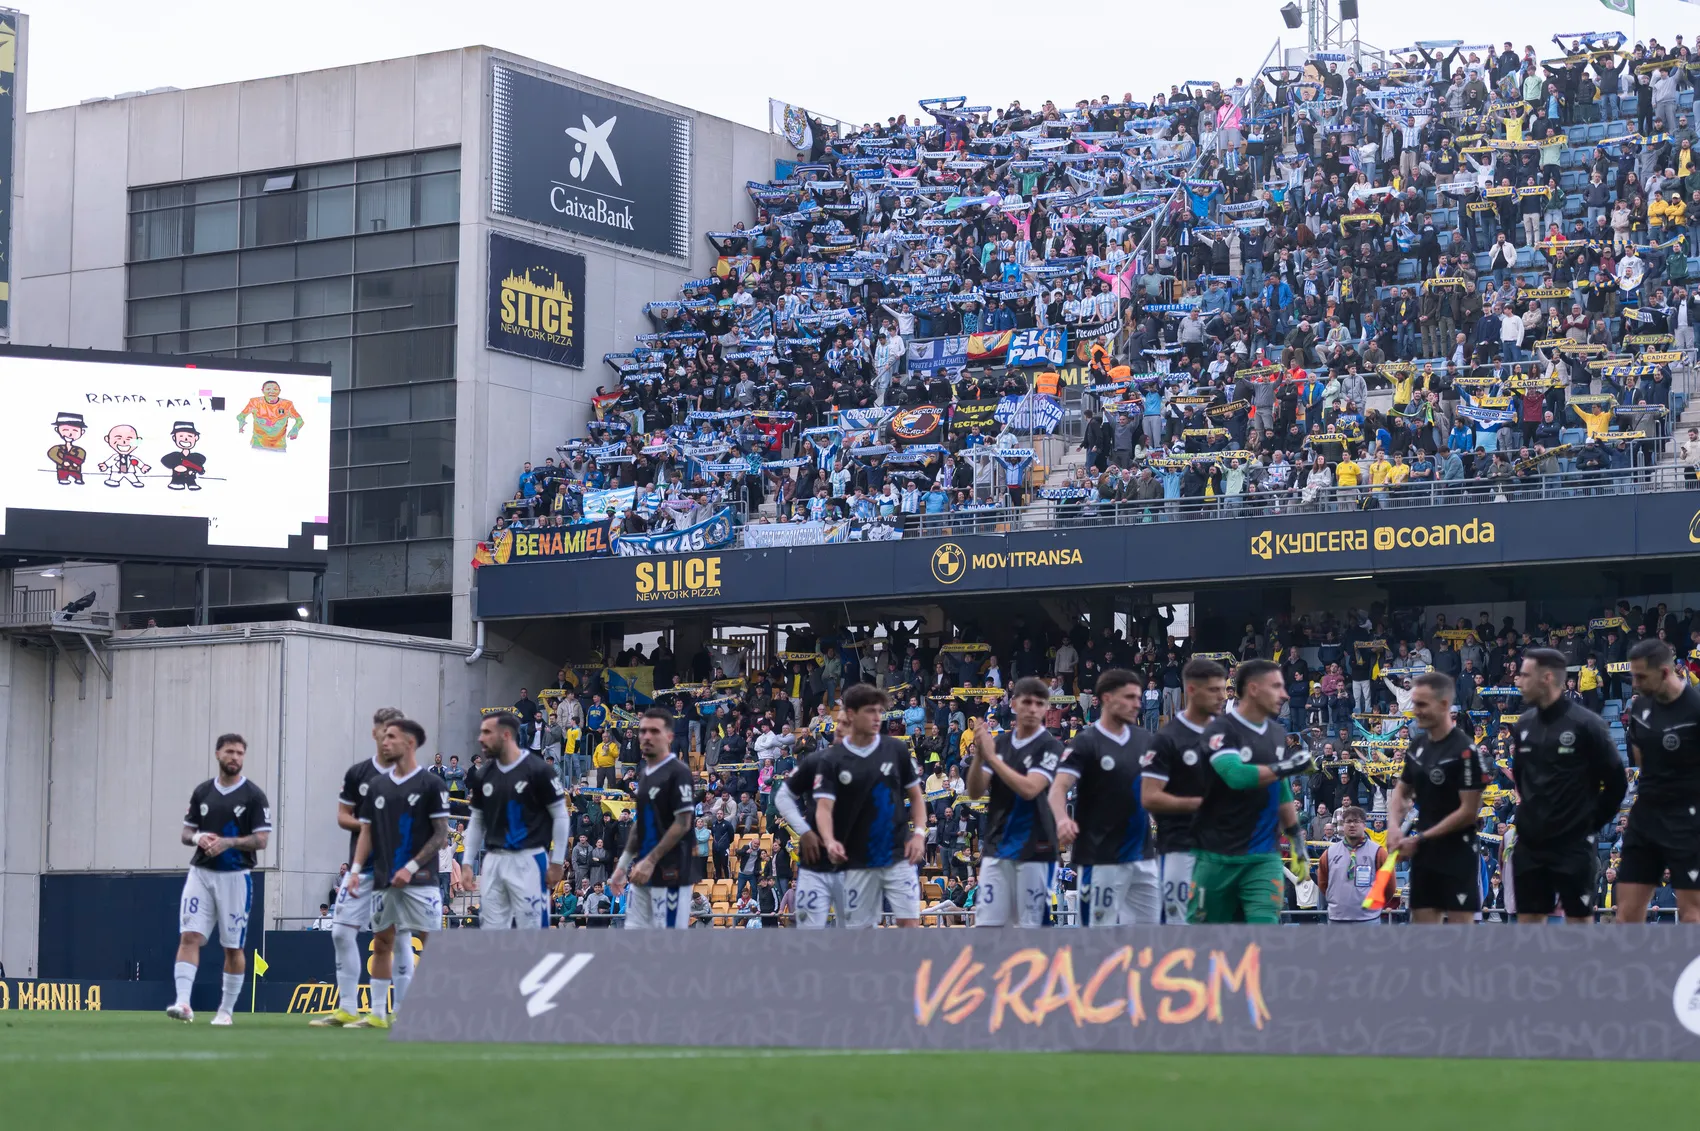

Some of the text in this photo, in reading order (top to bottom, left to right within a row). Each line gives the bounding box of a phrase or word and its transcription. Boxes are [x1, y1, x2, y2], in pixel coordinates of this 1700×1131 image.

[1317, 53, 1346, 62] MALAGA
[550, 186, 635, 231] CaixaBank
[684, 278, 714, 289] MALAGA
[501, 287, 573, 338] SLICE
[500, 323, 573, 347] NEW YORK PIZZA
[1013, 331, 1041, 347] EL
[727, 352, 750, 360] FONDO
[1009, 348, 1063, 364] PALO
[85, 392, 191, 408] RATATA TATA
[516, 528, 607, 557] BENAMIEL
[1276, 517, 1496, 555] KYOCERA coanda
[972, 549, 1083, 570] MOVITRANSA
[635, 557, 722, 593] SLICE
[636, 588, 721, 602] NEW YORK PIZZA
[1370, 766, 1391, 774] CADIZ
[338, 887, 347, 904] 9
[797, 889, 818, 909] 22
[1094, 886, 1112, 907] 16
[1166, 882, 1188, 904] 20
[183, 897, 199, 915] 18
[18, 982, 101, 1011] MANILA
